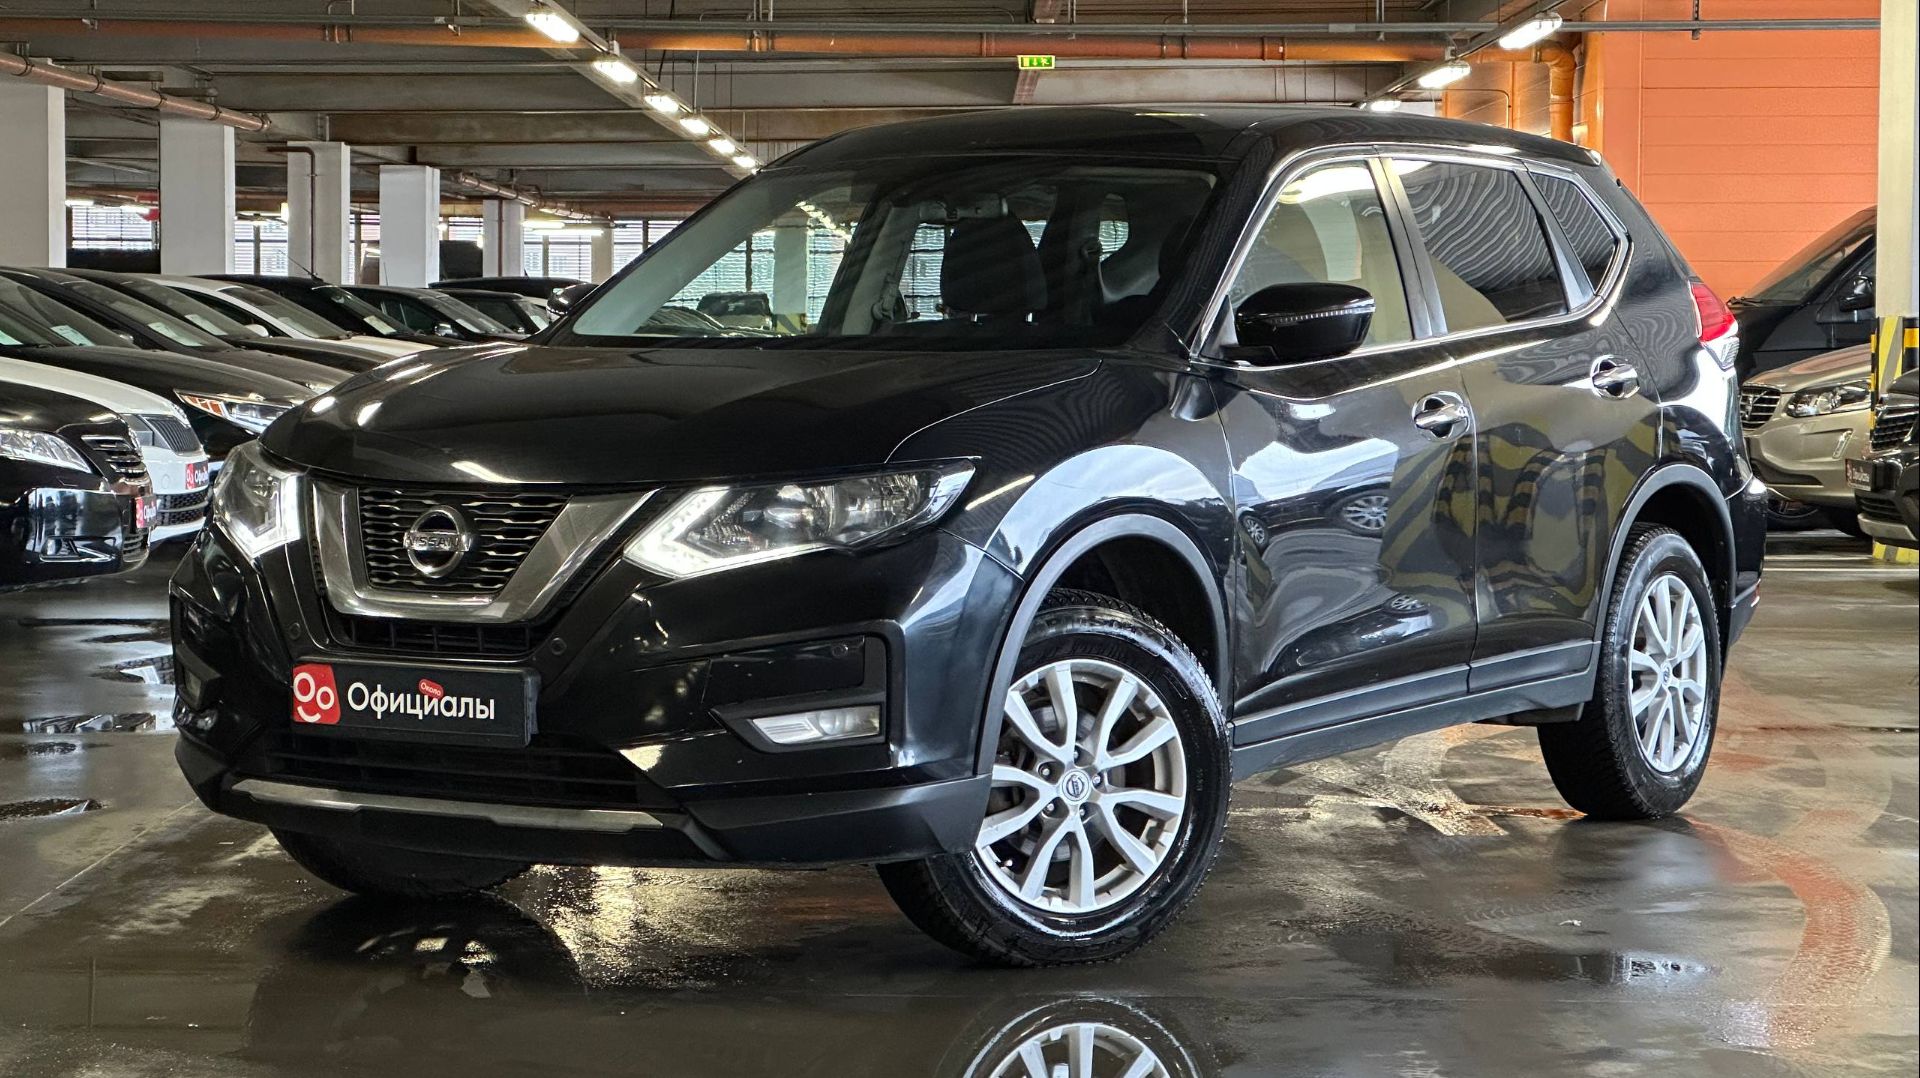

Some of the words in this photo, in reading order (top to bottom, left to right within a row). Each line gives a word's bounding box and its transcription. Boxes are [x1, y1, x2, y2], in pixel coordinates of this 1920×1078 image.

[407, 534, 460, 550] NISSAN
[420, 681, 442, 696] Около
[347, 682, 495, 720] Официалы
